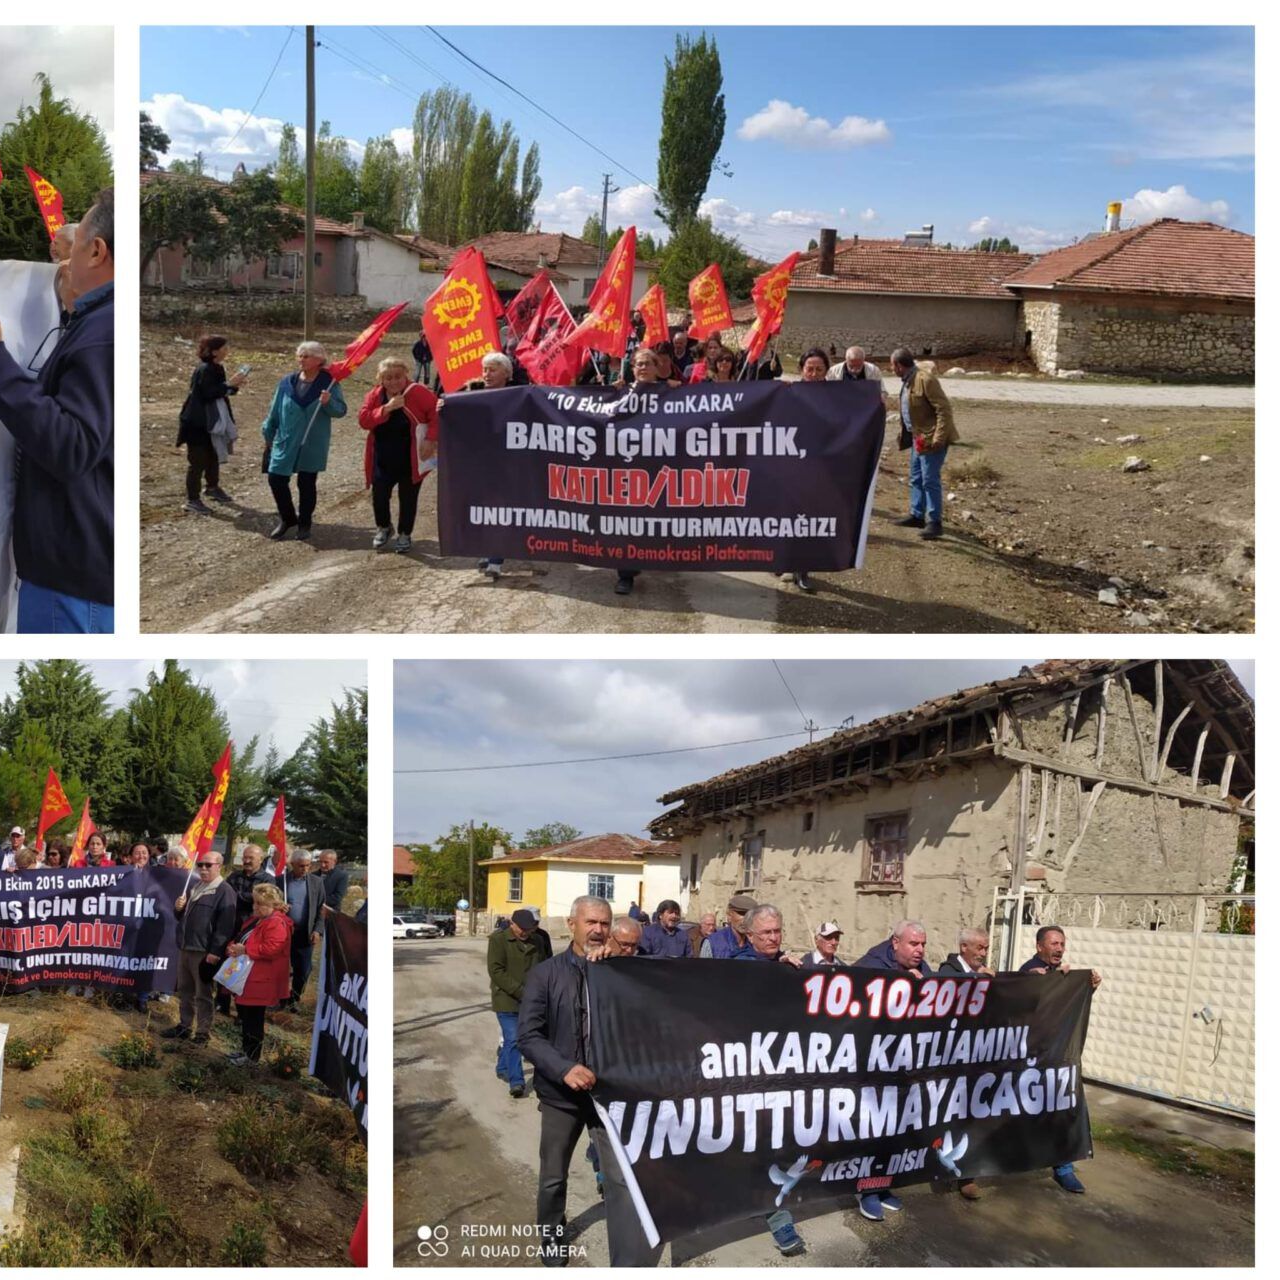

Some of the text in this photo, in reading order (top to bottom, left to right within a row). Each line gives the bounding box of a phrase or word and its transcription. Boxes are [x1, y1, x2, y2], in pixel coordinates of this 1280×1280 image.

[577, 394, 617, 415] Ekim
[618, 392, 659, 414] 2015
[506, 420, 807, 462] BARIŞ İÇİN GİTTİK,
[470, 506, 837, 538] UNUTMADIK, UNUTTURMAYACAĞIZ!
[527, 534, 774, 562] Çorum Emek ve Demokrasi Platformu
[5, 877, 32, 891] Ekim
[36, 876, 64, 890] 2015
[28, 896, 77, 921] İÇİN
[82, 893, 160, 920] GİTTİK,
[26, 952, 169, 971] UNUTTURMAYACAĞIZ!
[31, 972, 41, 982] ve
[43, 969, 92, 981] Demokrasi
[94, 970, 136, 986] Platformu
[803, 974, 991, 1020] 10.10.2015
[701, 1018, 1030, 1080] anKARA KATLİAMINI
[610, 1058, 1077, 1166] UNUTTURMAYACAĞIZ!
[820, 1155, 876, 1182] KESK
[886, 1146, 929, 1175] DİSK
